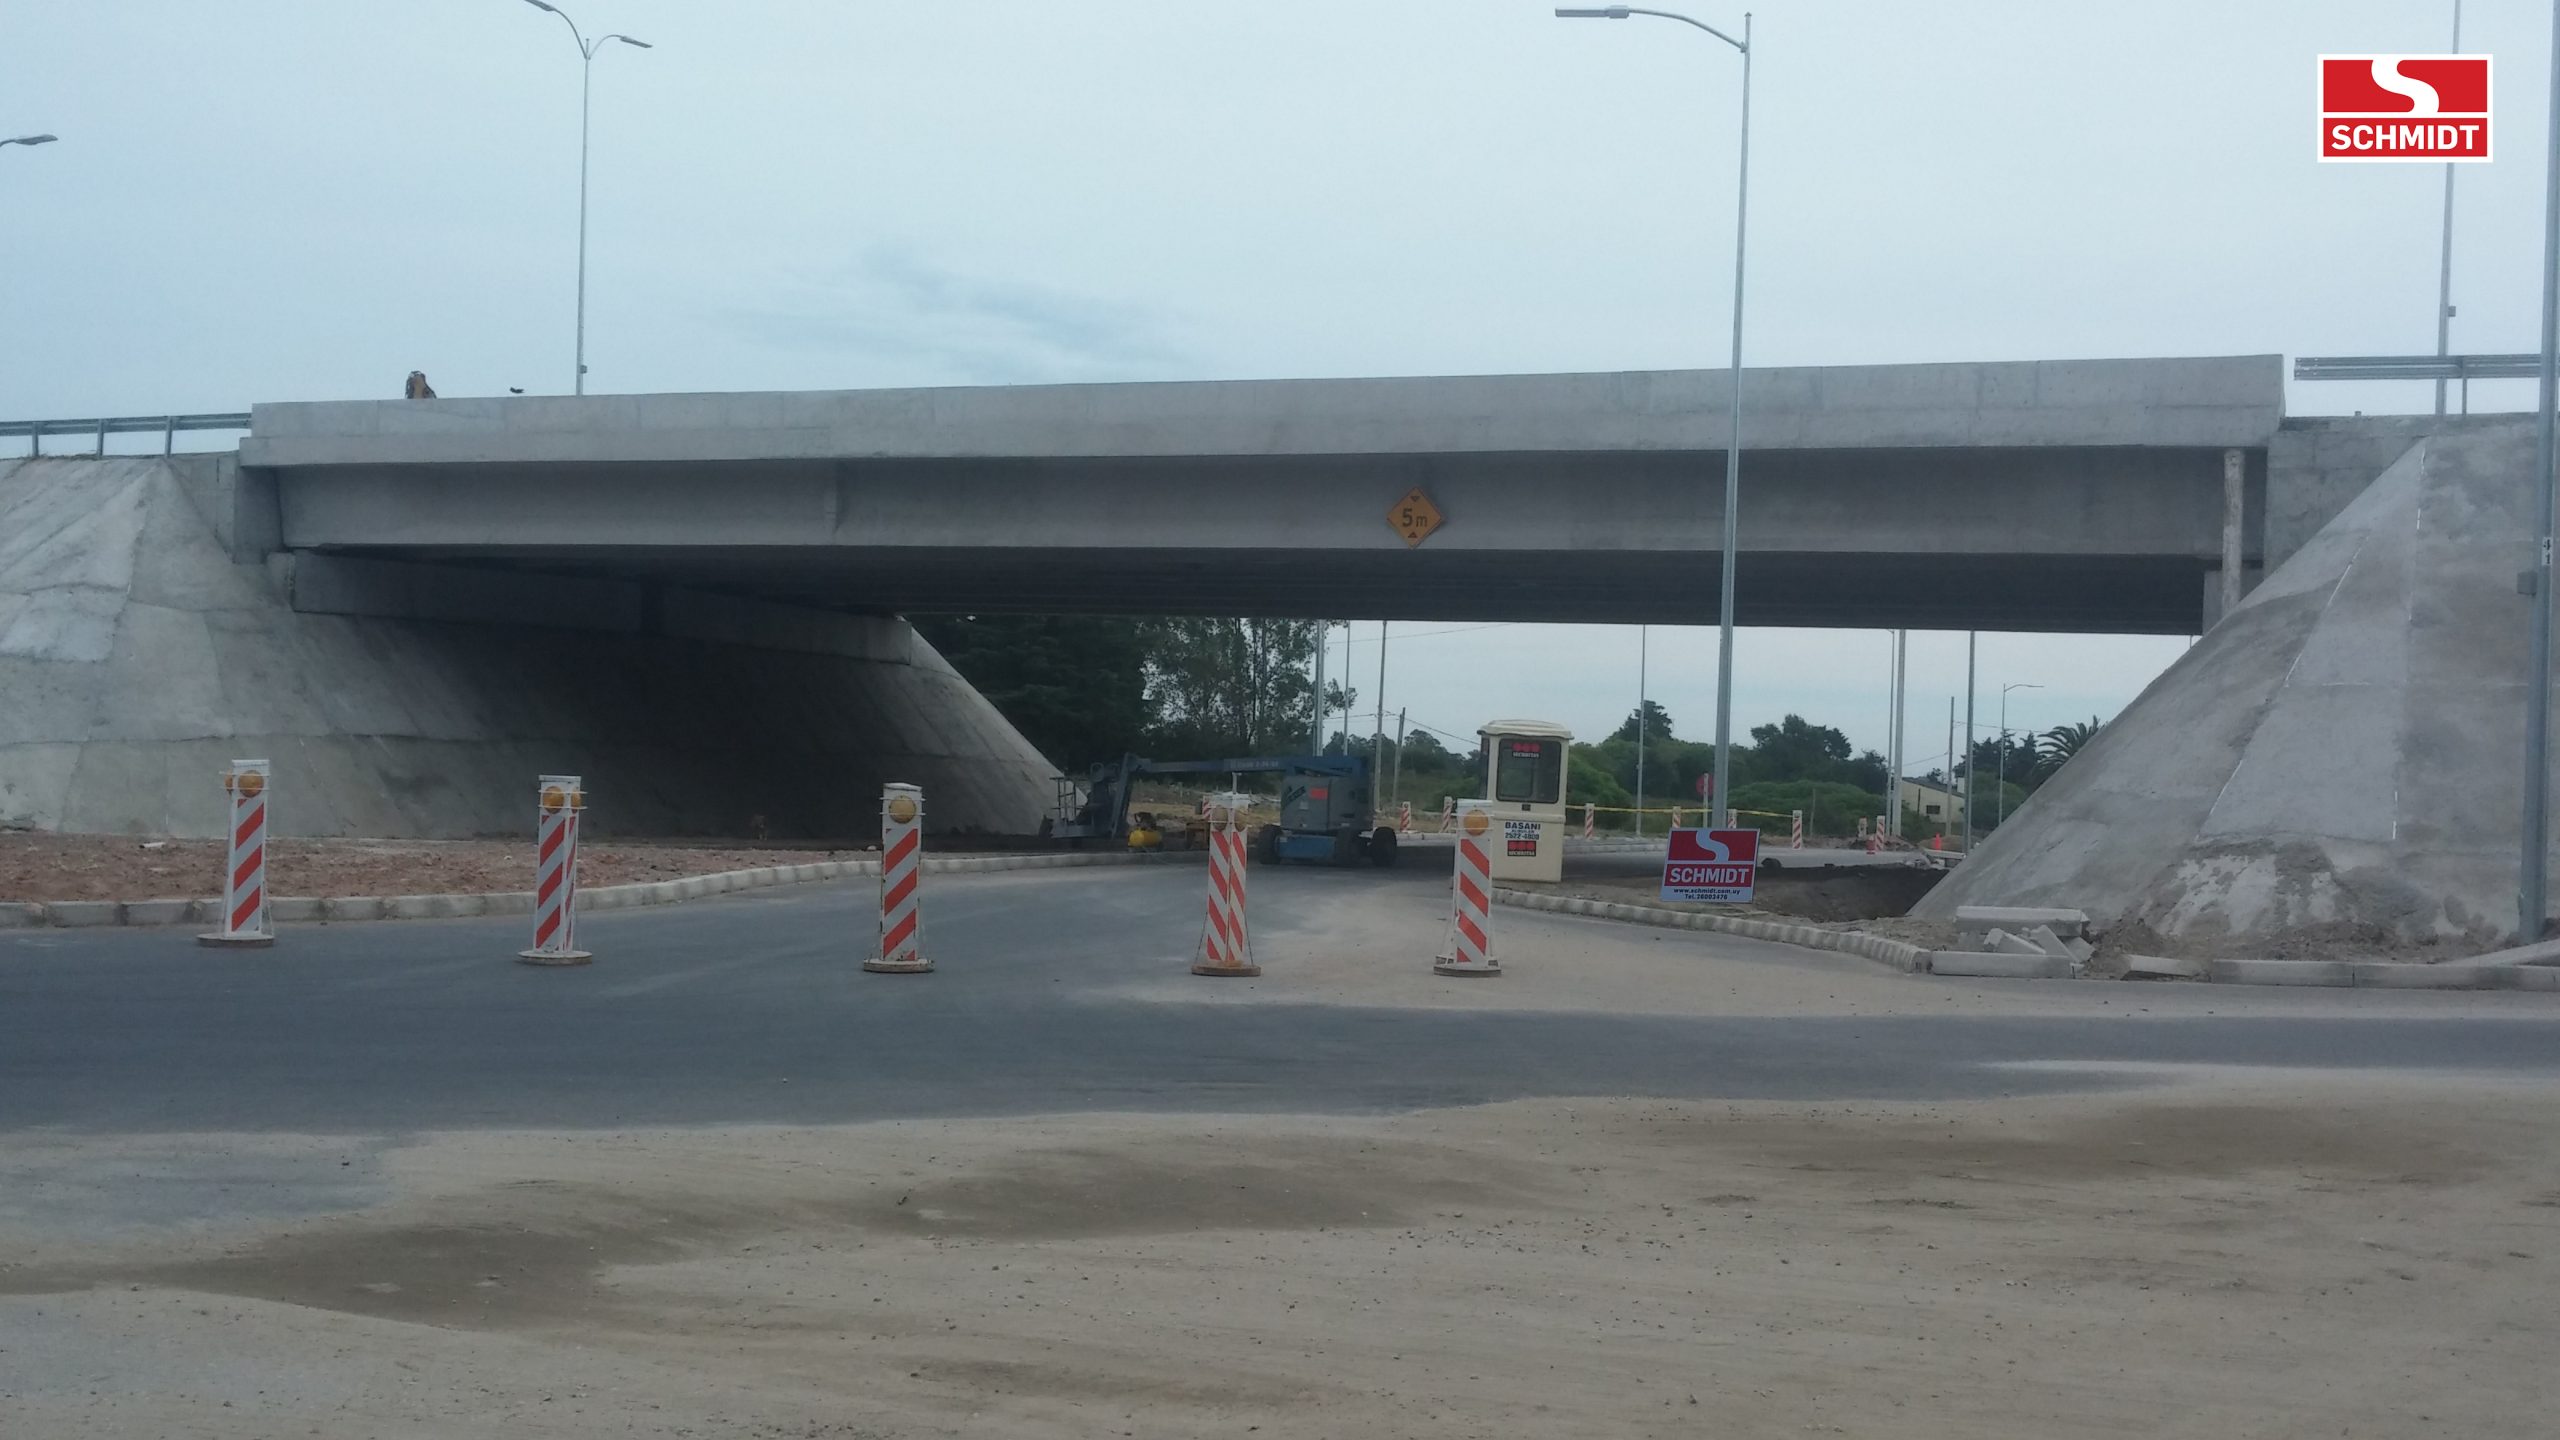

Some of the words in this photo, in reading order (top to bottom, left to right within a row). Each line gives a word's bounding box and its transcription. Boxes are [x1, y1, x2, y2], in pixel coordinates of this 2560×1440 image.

[1504, 821, 1541, 831] BASANI
[1669, 867, 1749, 883] SCHMIDT
[1673, 887, 1741, 895] www.schmidt.com.uy
